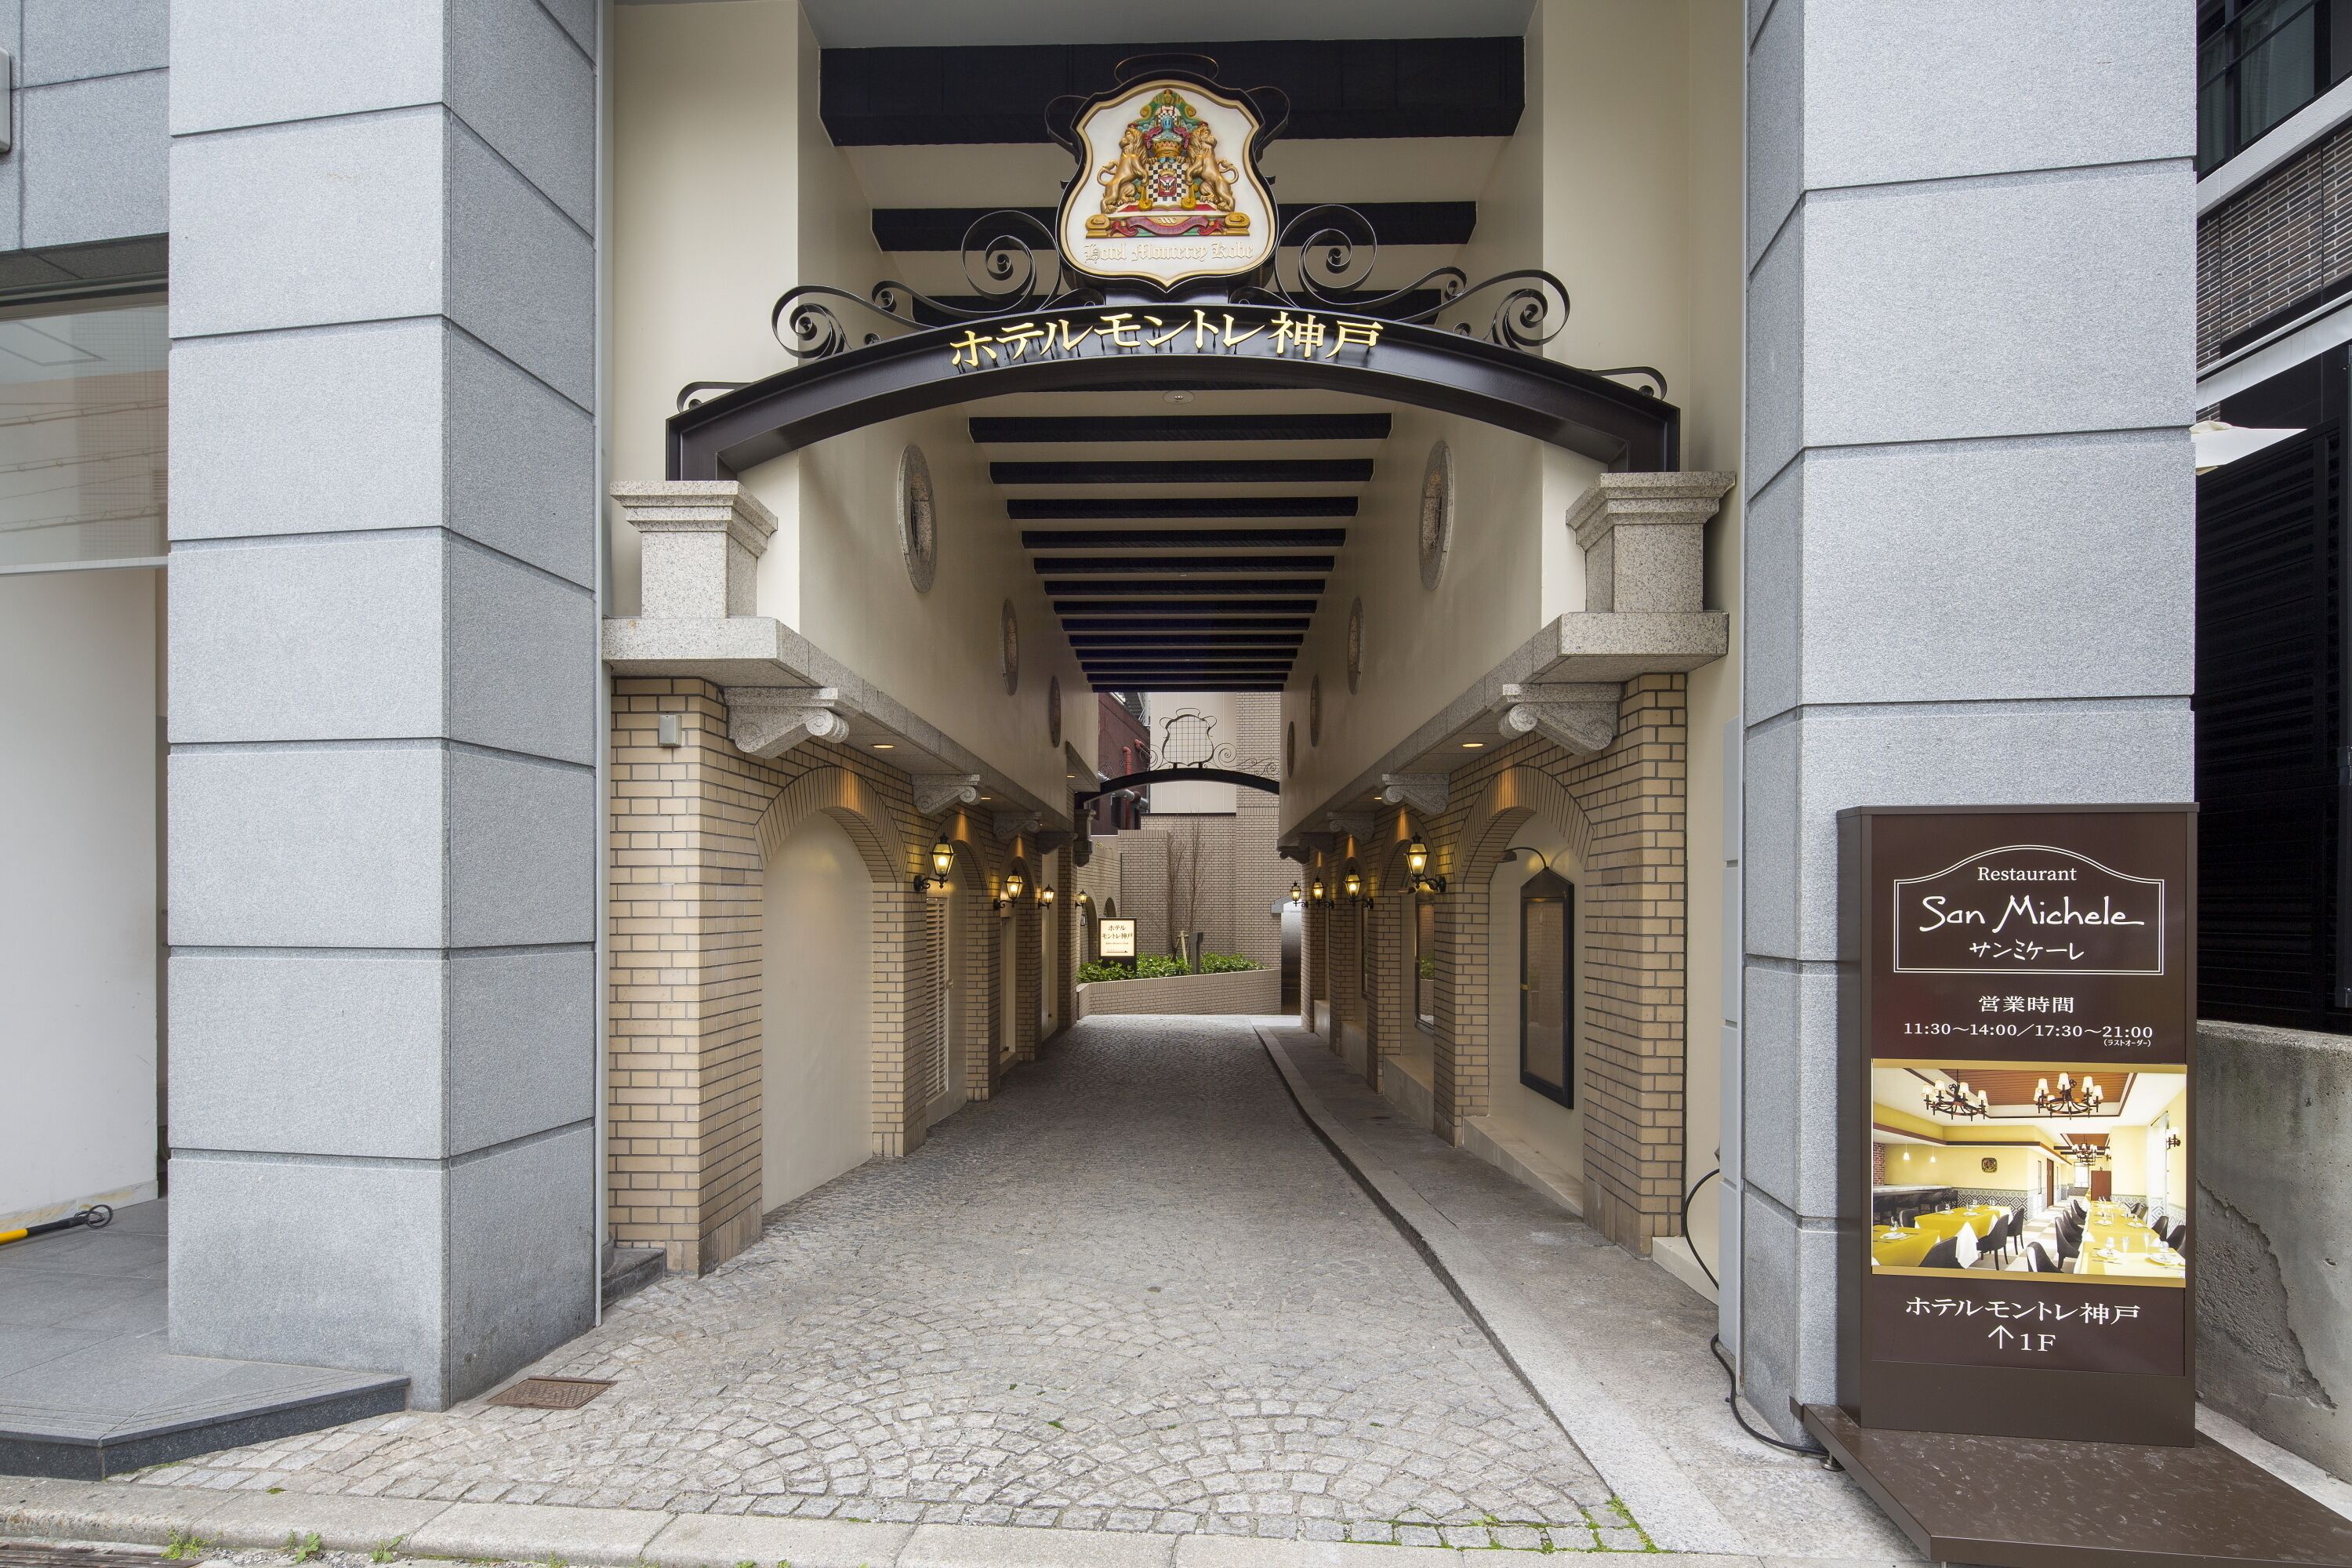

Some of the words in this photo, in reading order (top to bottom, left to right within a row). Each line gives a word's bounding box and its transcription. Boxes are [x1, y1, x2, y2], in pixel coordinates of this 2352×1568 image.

[949, 309, 1384, 367] ホテルモントレ神戸
[1977, 866, 2077, 881] Restaurant
[1918, 895, 1986, 932] San
[1991, 895, 2145, 933] Michele
[1969, 938, 2085, 960] サンミケーレ
[1978, 995, 2074, 1014] 営業時間
[1905, 1296, 2141, 1326] ホテルモントレ神戸
[2020, 1334, 2056, 1352] 1F
